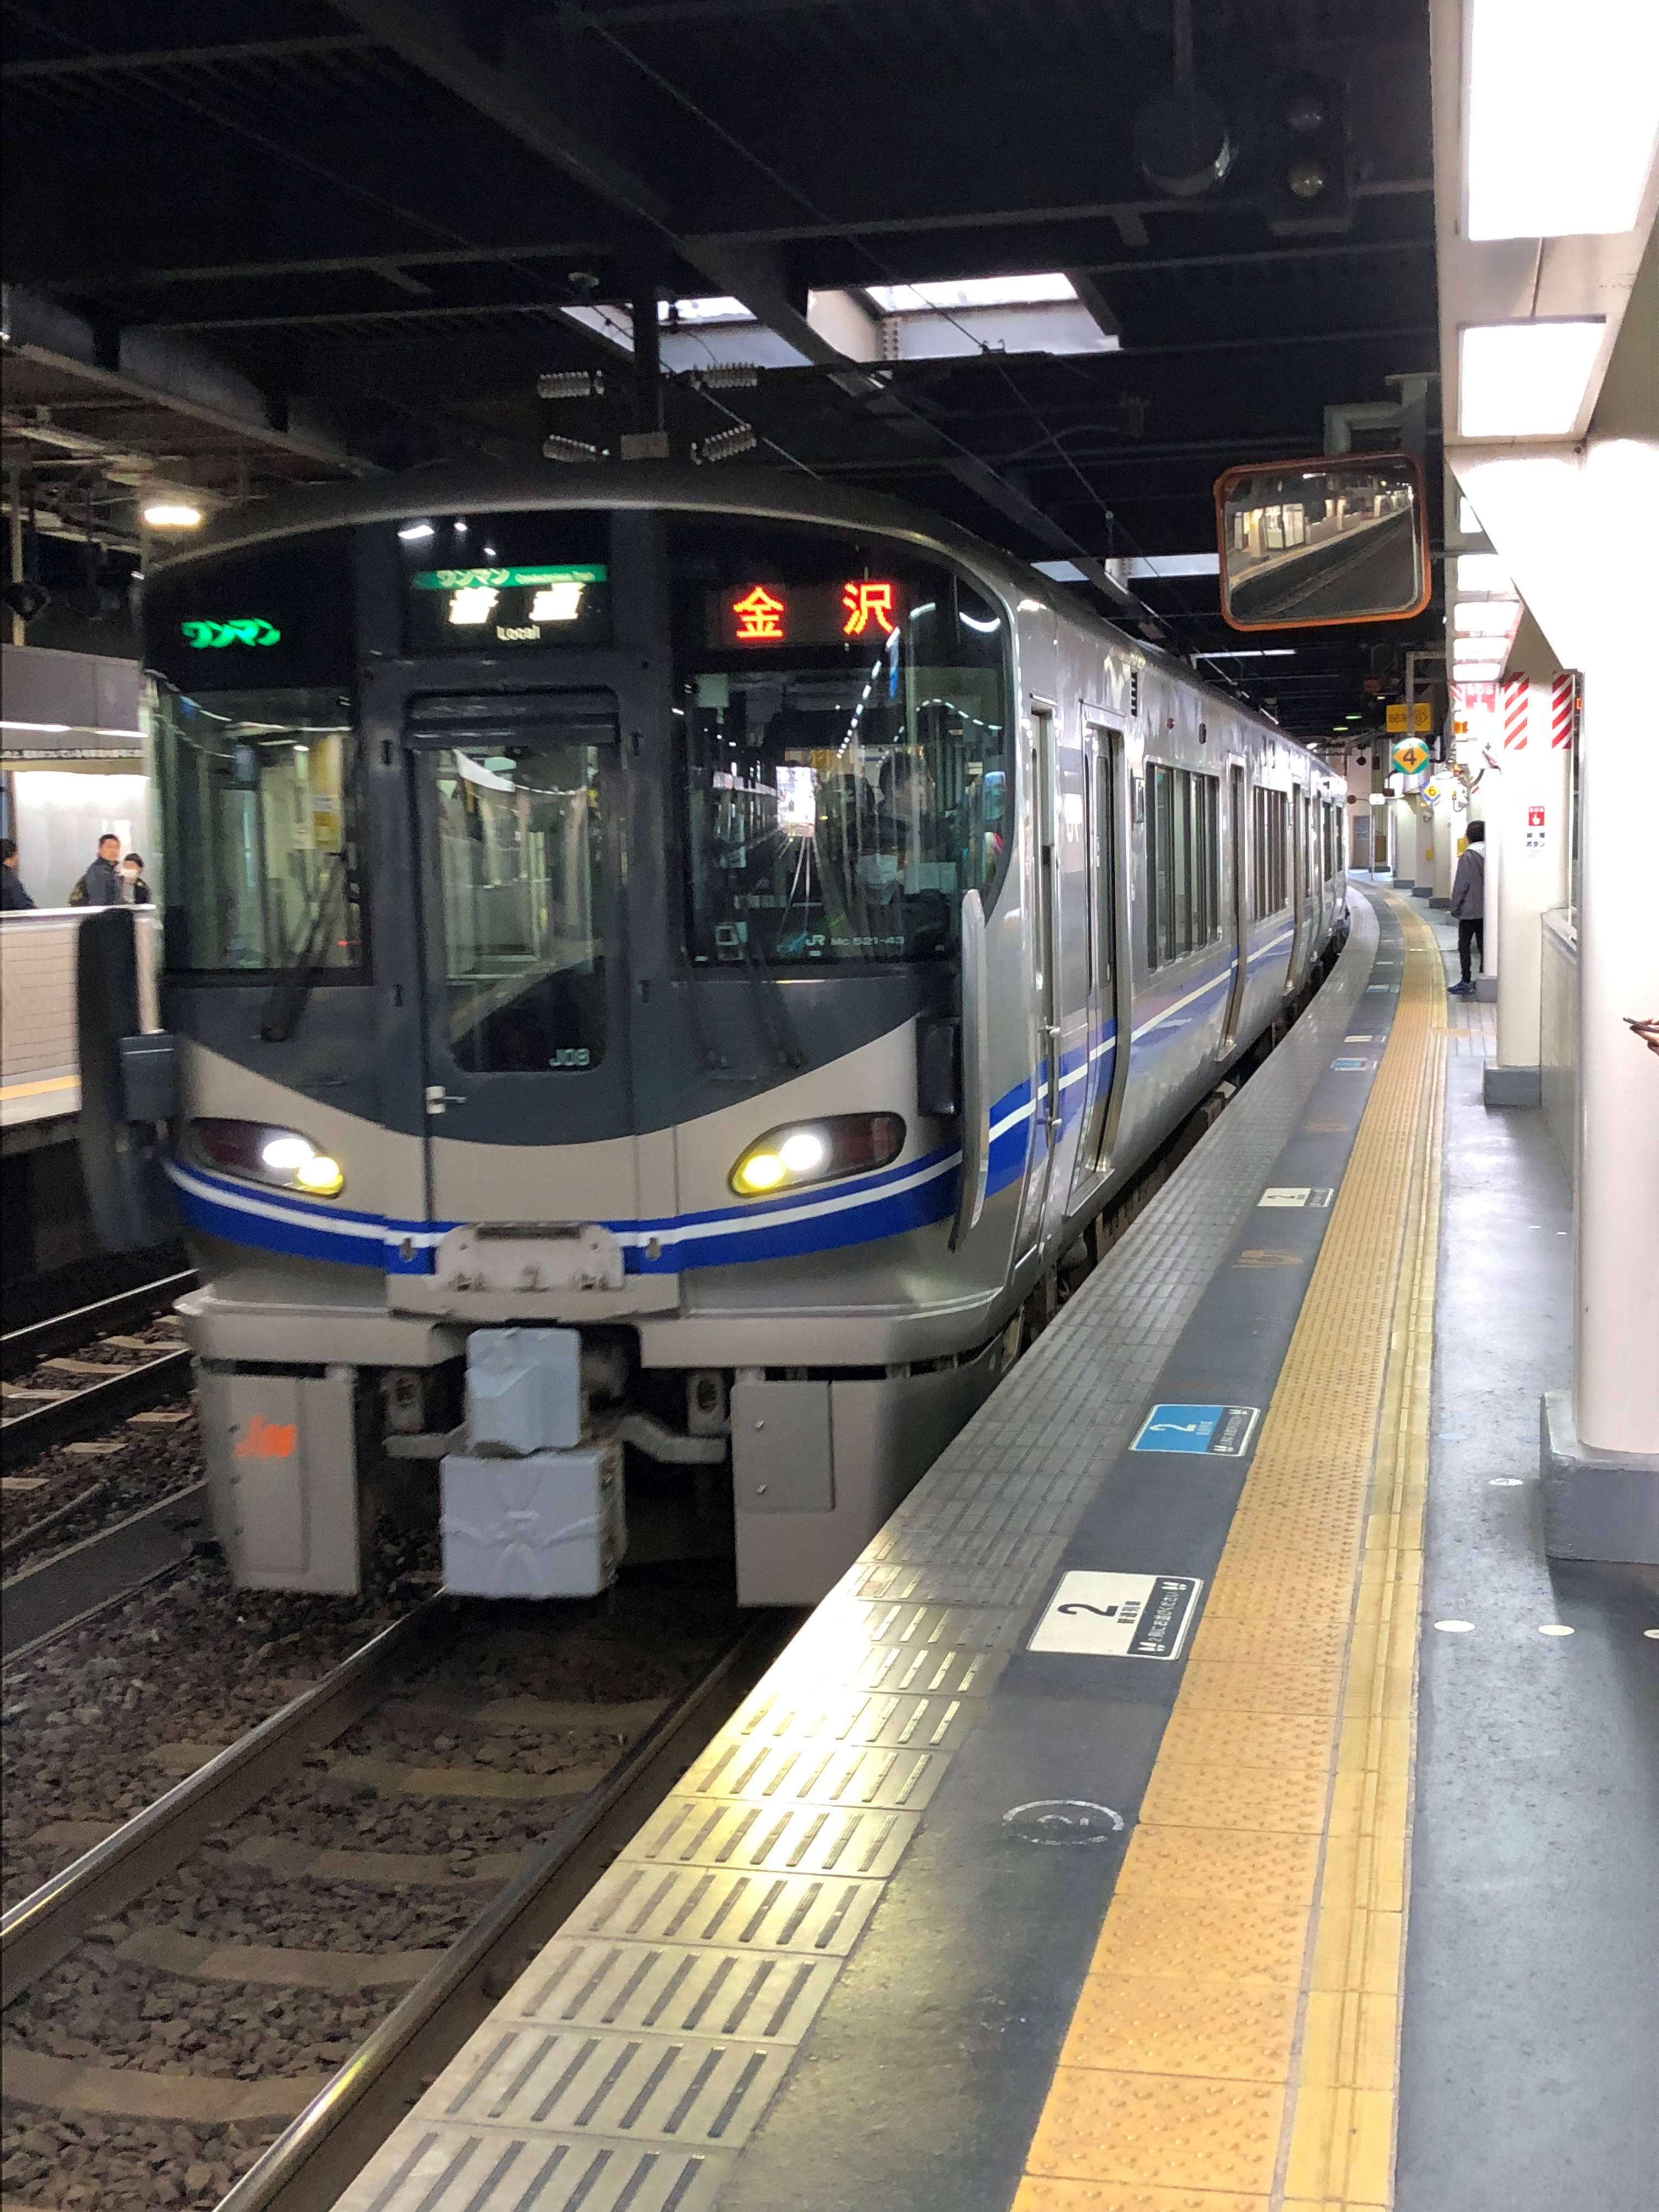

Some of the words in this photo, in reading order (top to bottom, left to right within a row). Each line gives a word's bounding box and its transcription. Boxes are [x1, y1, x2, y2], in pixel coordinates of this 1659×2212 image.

[733, 582, 894, 638] 金沢
[496, 625, 540, 640] Local
[1403, 747, 1417, 766] 4
[1429, 786, 1436, 796] 6
[805, 934, 825, 946] JR
[1149, 1424, 1197, 1432] 2
[1057, 1602, 1119, 1617] 2
